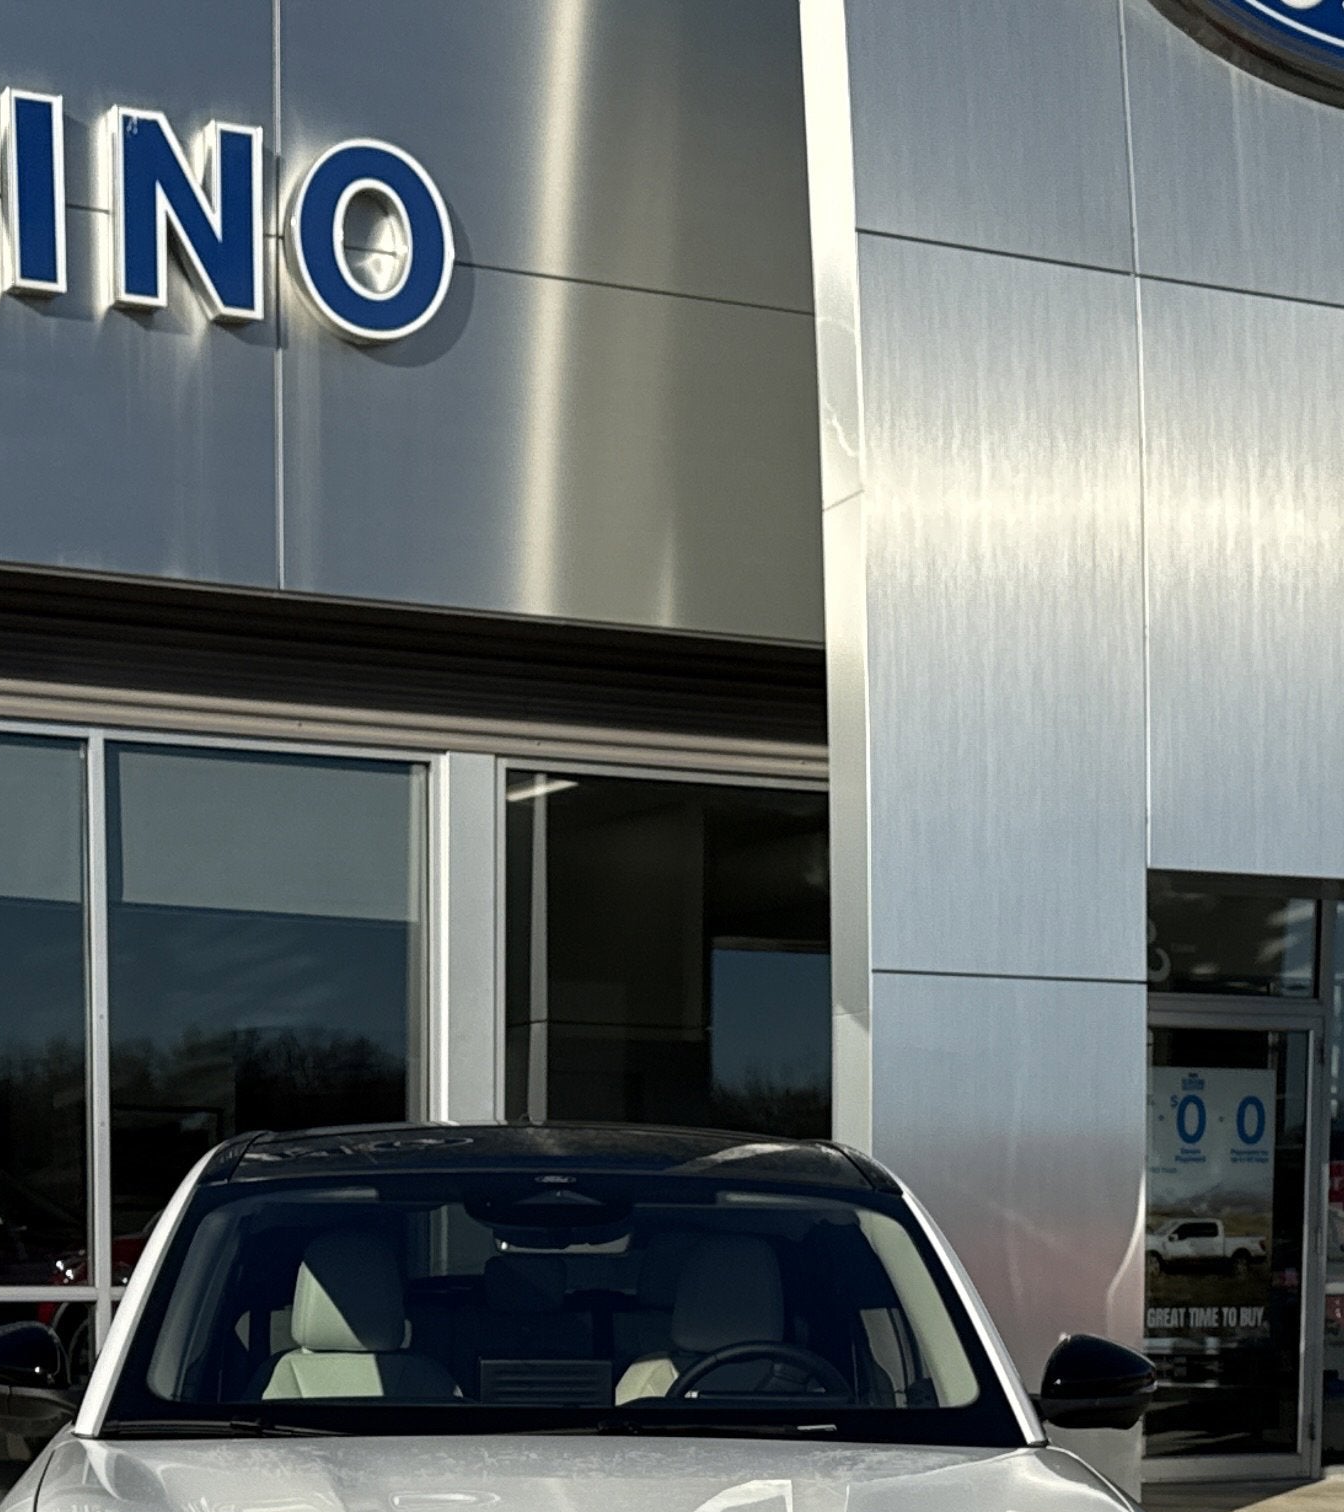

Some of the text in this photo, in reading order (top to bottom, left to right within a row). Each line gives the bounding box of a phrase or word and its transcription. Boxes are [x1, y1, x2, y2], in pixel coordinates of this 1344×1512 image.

[1236, 1095, 1265, 1144] 0
[1147, 1307, 1186, 1328] GREAT
[1188, 1307, 1219, 1328] TIME
[1221, 1307, 1237, 1327] TO
